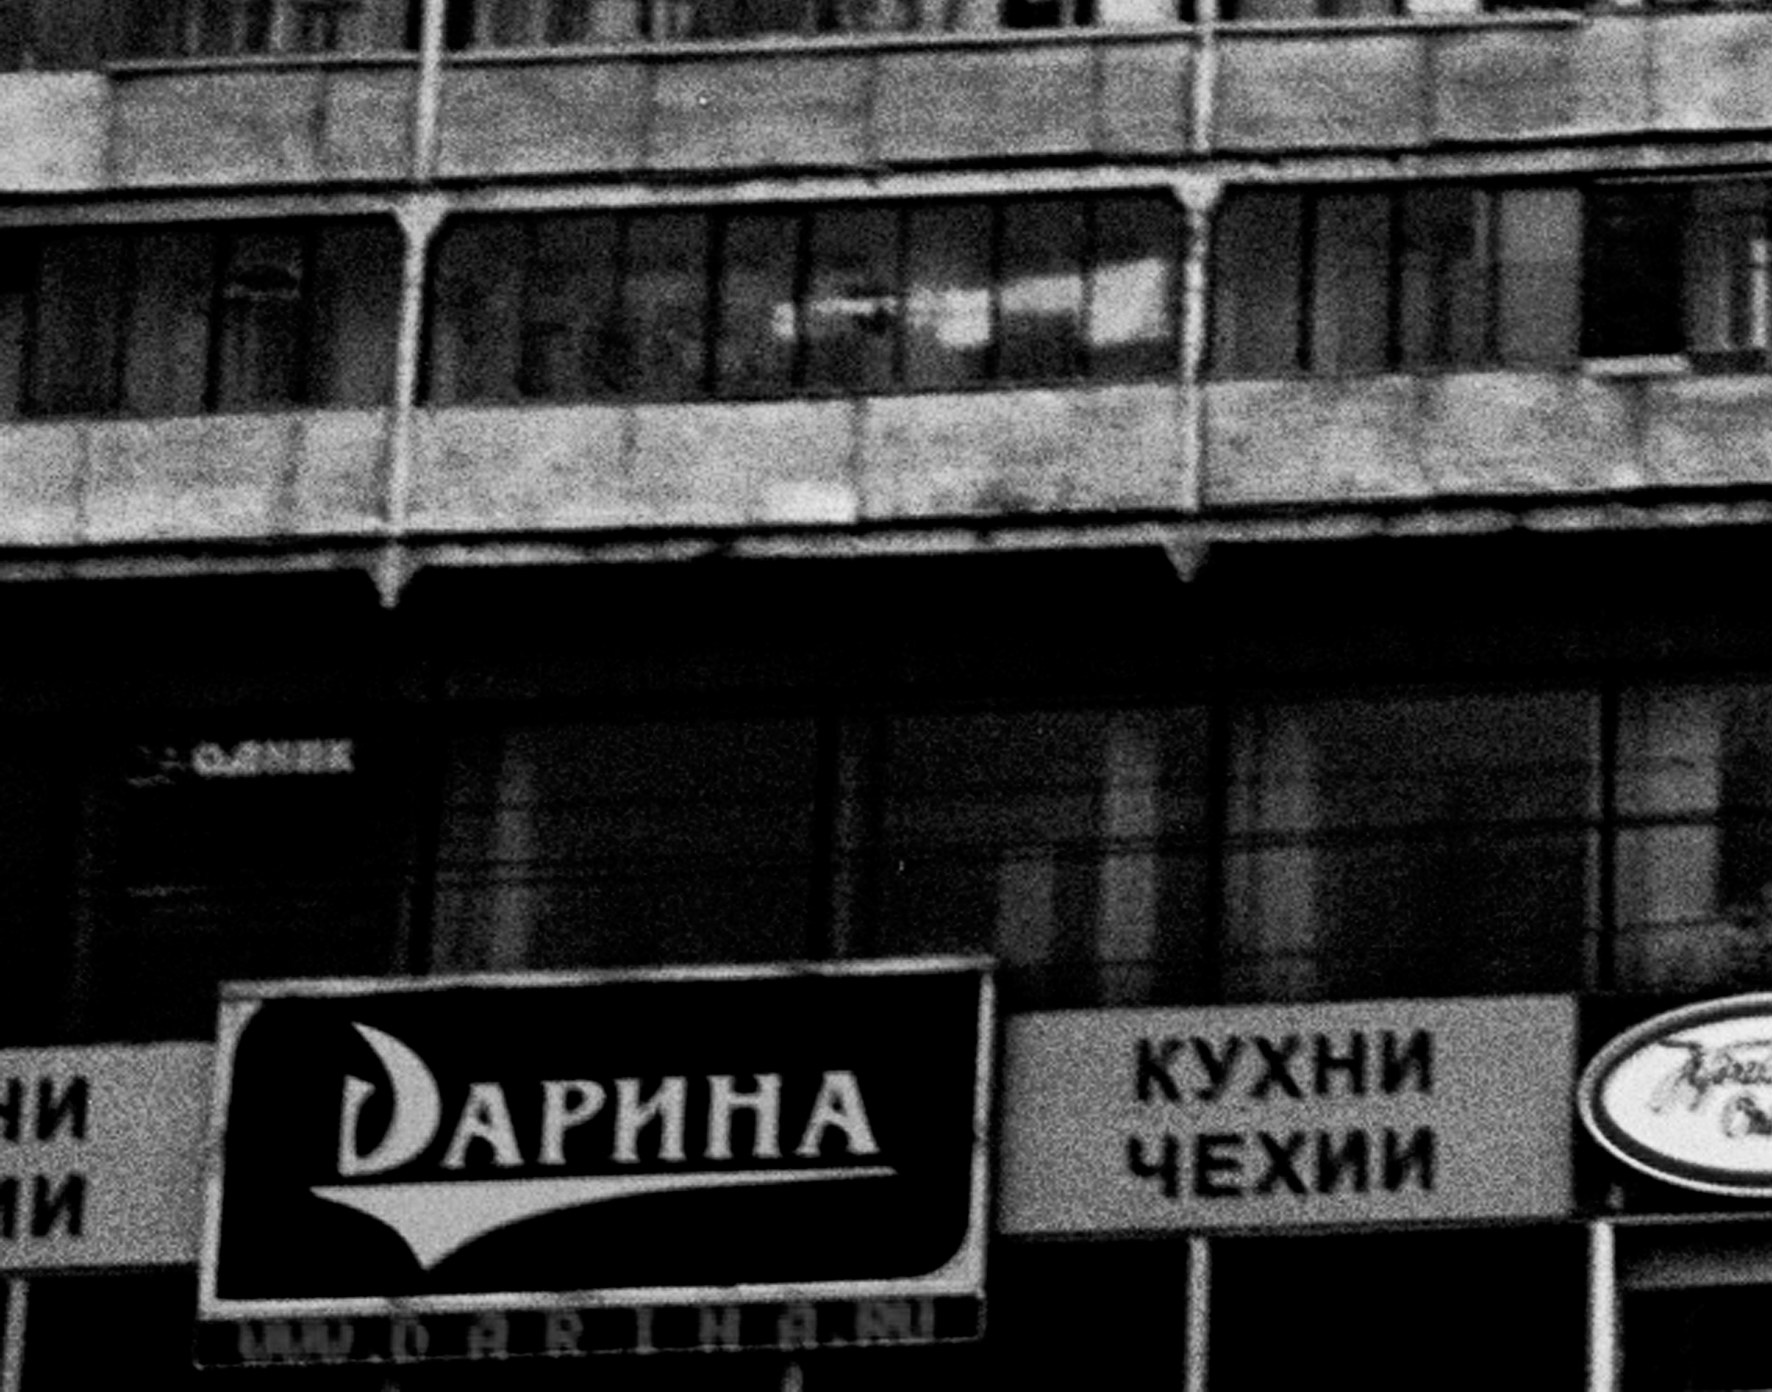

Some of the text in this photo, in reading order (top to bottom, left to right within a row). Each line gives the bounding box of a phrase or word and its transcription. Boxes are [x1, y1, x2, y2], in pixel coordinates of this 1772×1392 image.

[337, 1022, 880, 1176] ДАРИНА
[1133, 1027, 1436, 1105] КУХНИ
[1125, 1125, 1438, 1199] ЧЕХИИ
